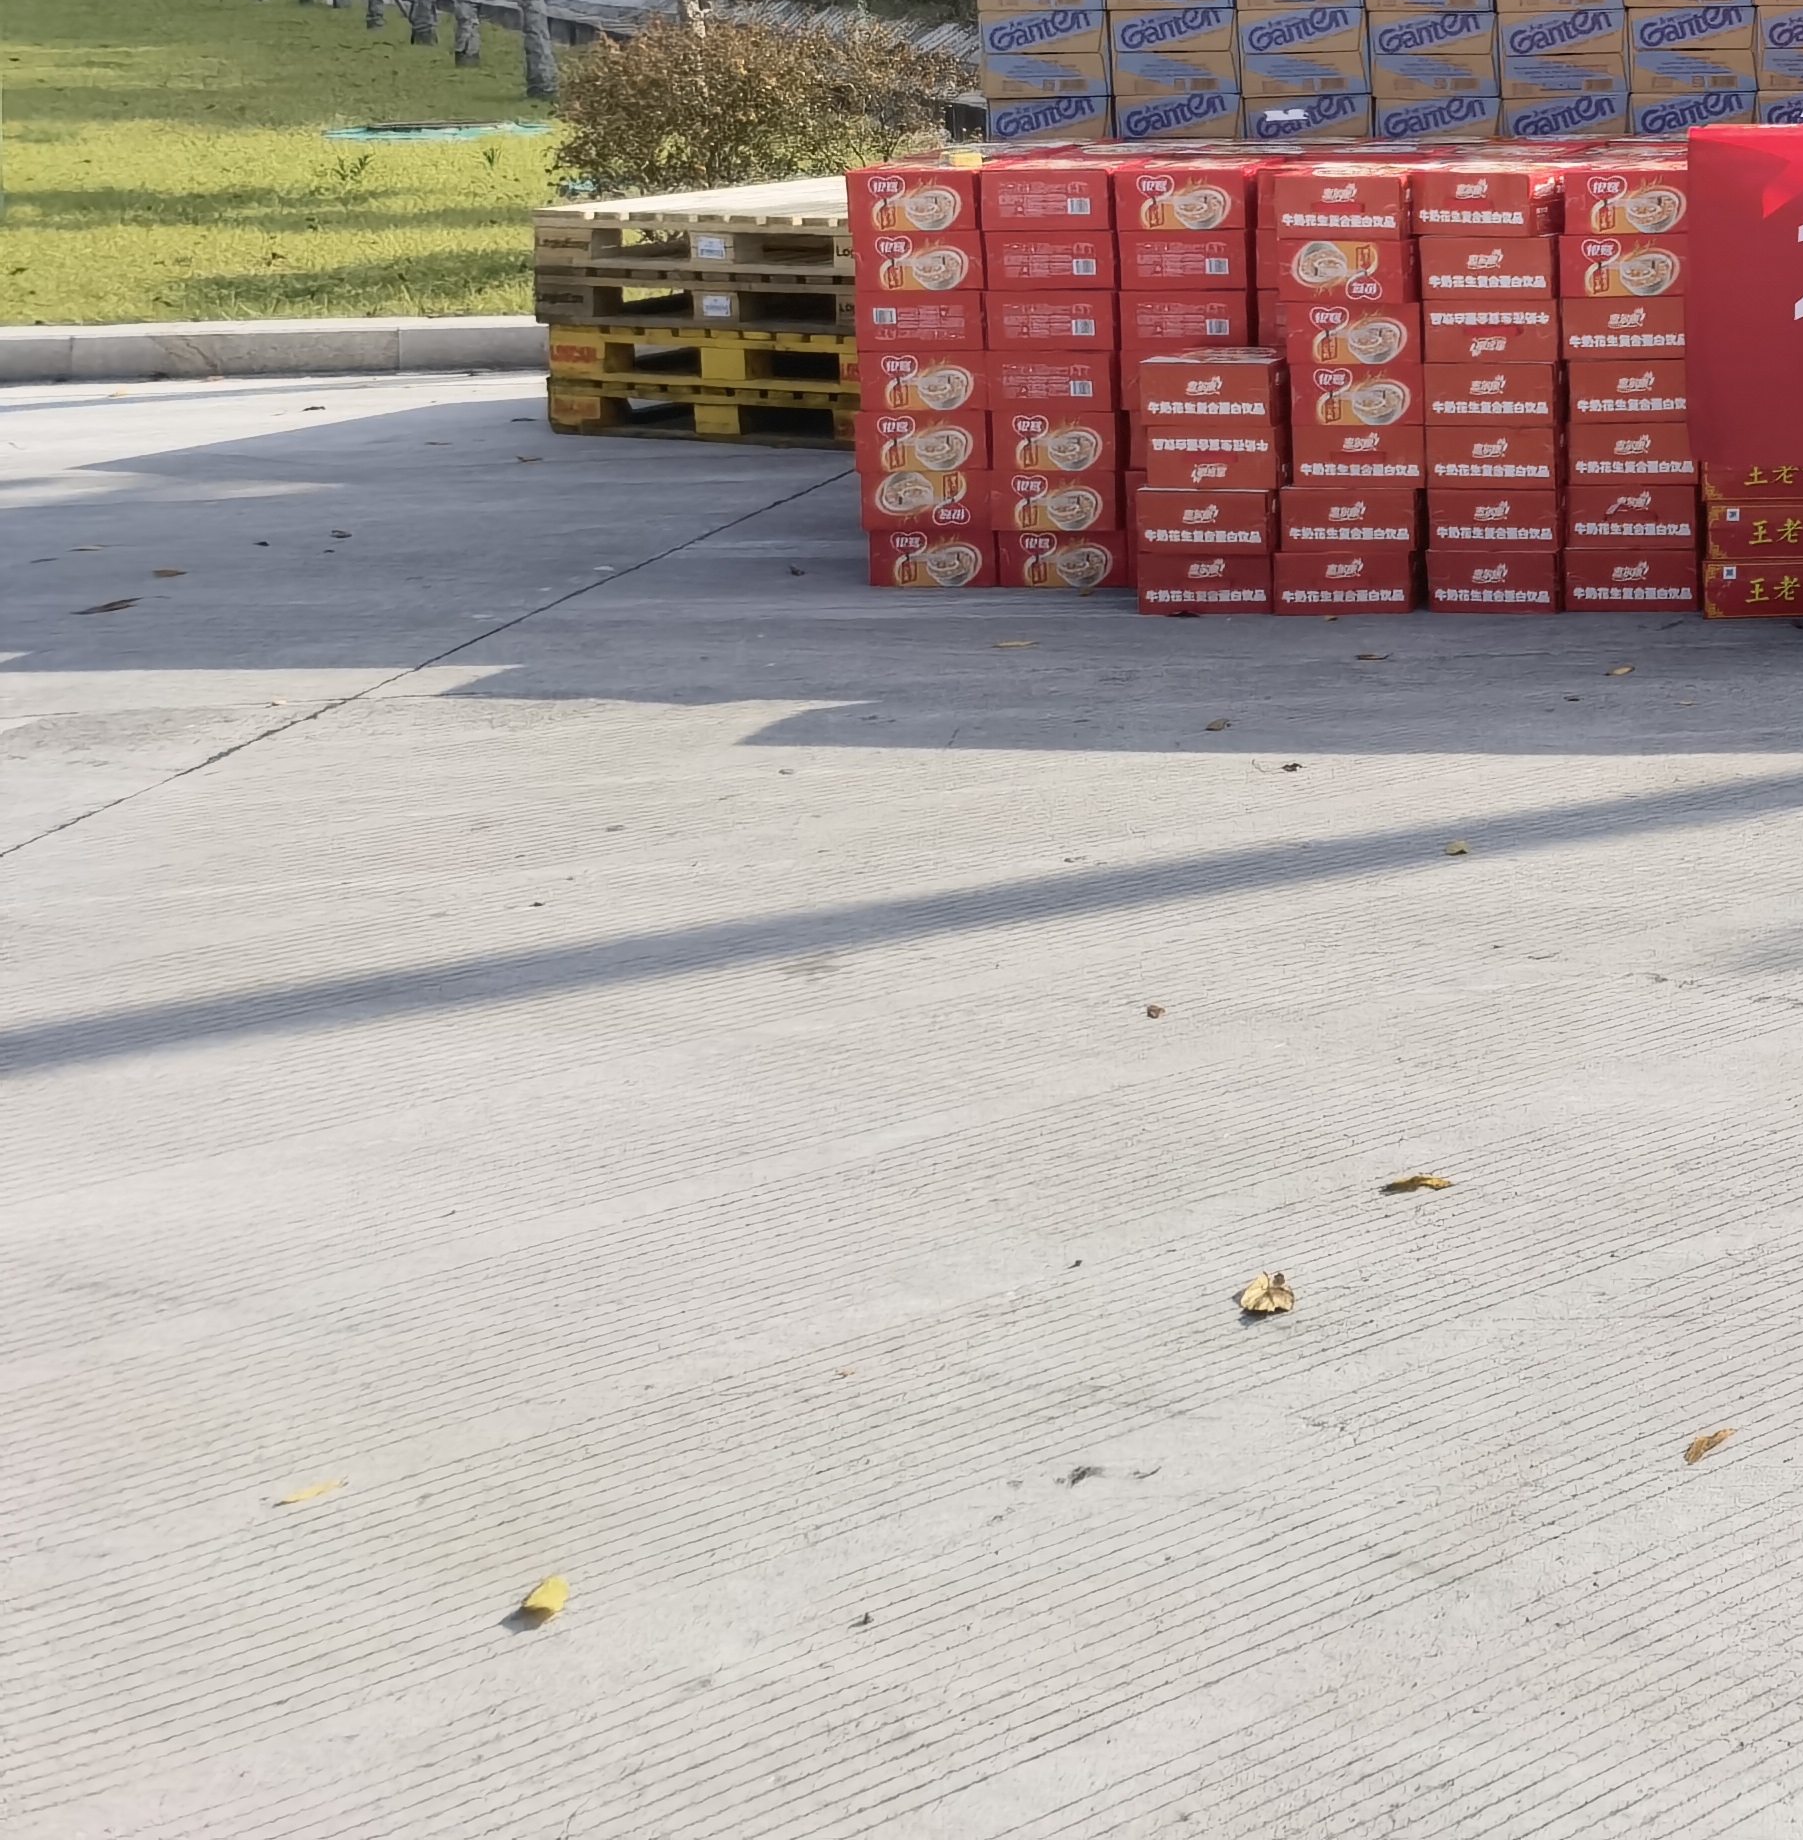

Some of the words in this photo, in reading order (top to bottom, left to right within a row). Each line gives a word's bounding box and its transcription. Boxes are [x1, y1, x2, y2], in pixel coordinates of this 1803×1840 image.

[989, 8, 1093, 53] Ganten
[1248, 8, 1351, 52] Ganten
[1639, 4, 1744, 49] Ganten
